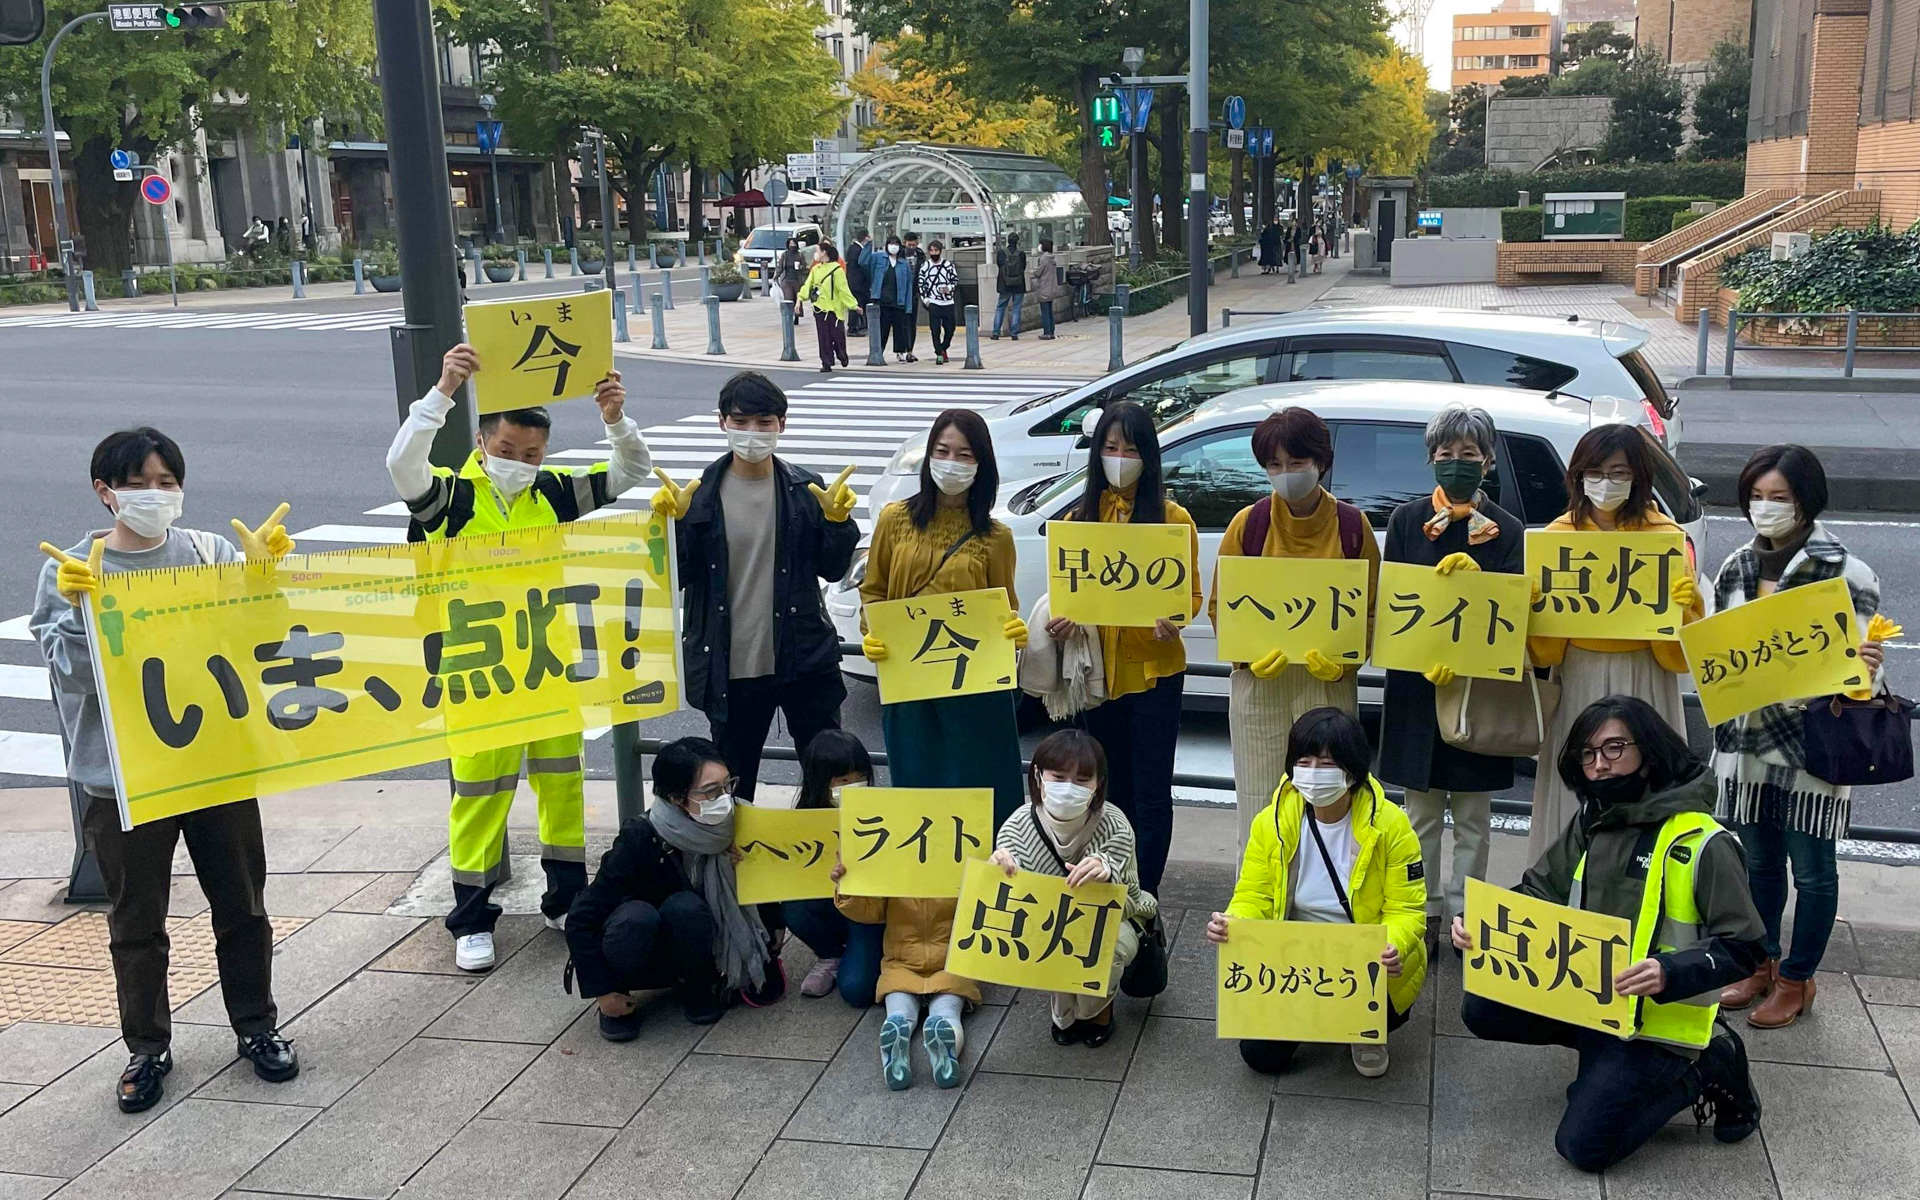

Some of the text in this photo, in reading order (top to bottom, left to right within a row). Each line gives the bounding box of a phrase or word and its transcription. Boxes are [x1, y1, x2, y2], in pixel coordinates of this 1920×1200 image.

[510, 302, 573, 326] いま
[511, 324, 582, 396] 今
[291, 571, 322, 582] 50cm
[488, 547, 520, 557] 100cm
[1052, 546, 1186, 593] 早めの
[345, 578, 469, 607] social distance
[1531, 546, 1683, 615] 点灯
[905, 597, 967, 620] いま
[1227, 586, 1362, 631] ヘッド
[1389, 592, 1515, 645] ライト
[911, 619, 980, 690] 今
[1700, 612, 1857, 685] ありがとう!
[740, 830, 840, 868] ヘッ
[852, 815, 981, 864] ライト
[957, 881, 1122, 968] 点灯
[1470, 903, 1628, 1005] 点灯
[1224, 961, 1380, 1012] ありがとう!
